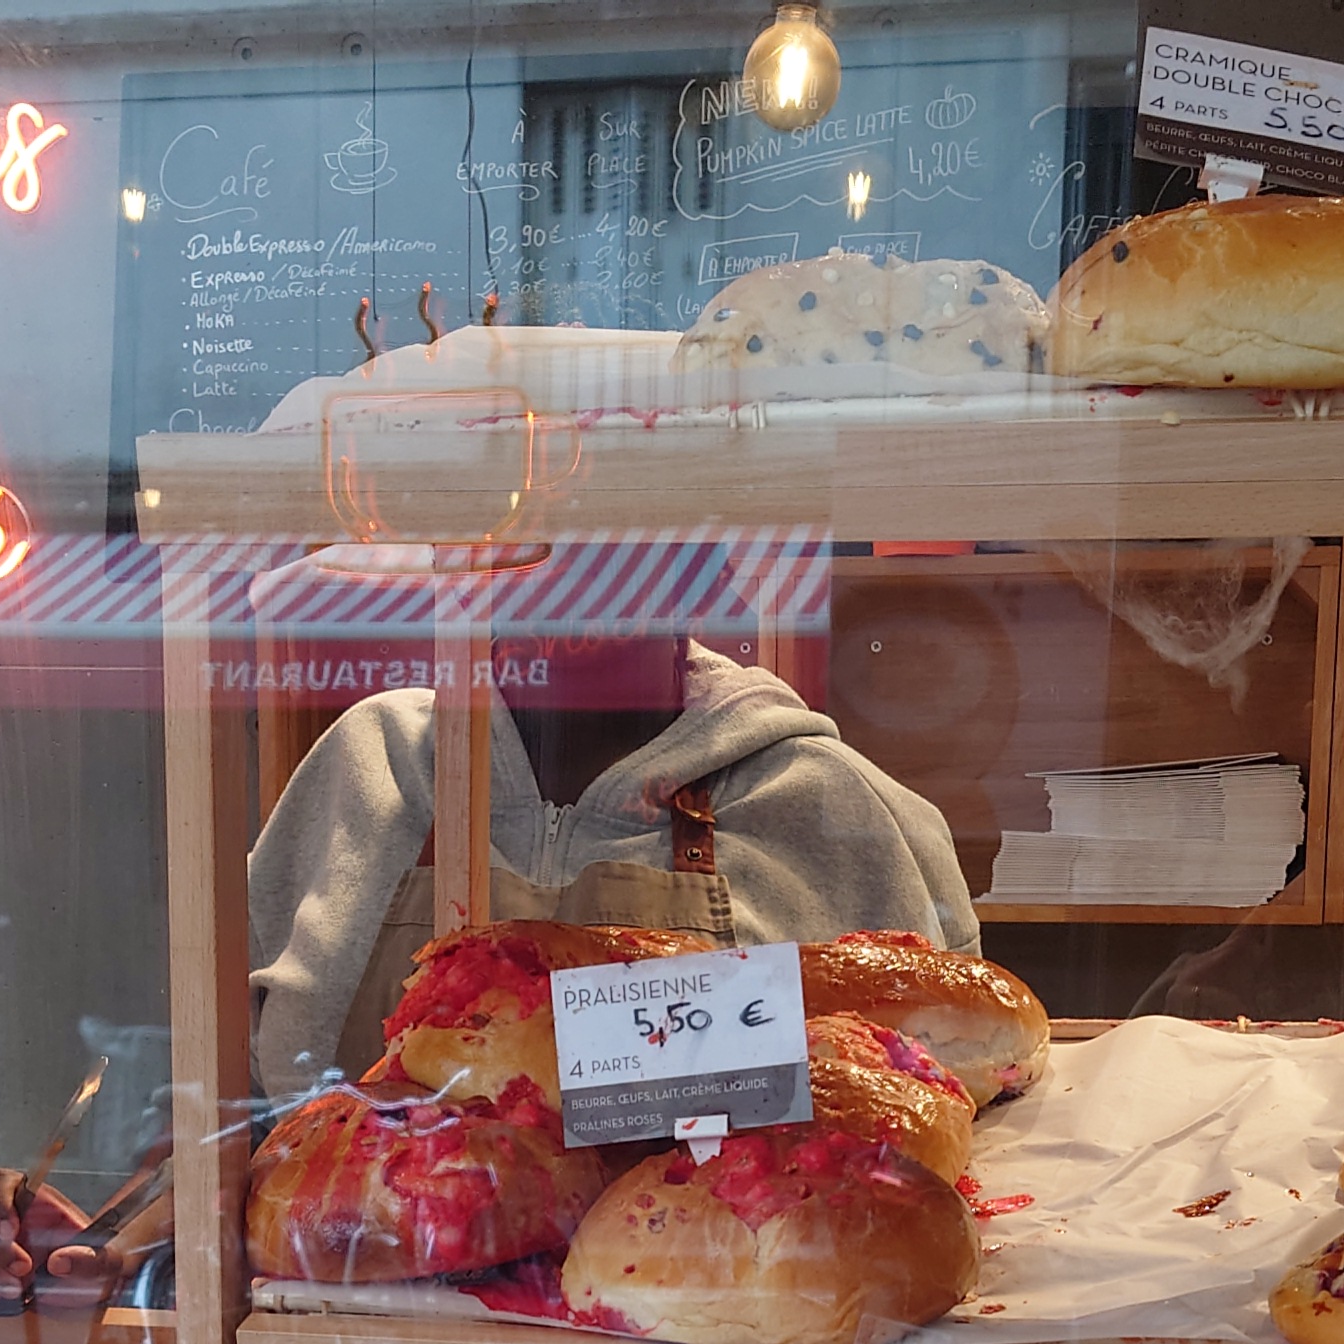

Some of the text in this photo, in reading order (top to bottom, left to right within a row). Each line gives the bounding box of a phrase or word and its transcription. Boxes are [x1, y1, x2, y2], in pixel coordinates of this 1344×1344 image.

[1155, 43, 1292, 81] CRAMIQUE
[1153, 66, 1256, 97] DOUBLE
[1150, 96, 1165, 111] 4
[1174, 100, 1229, 120] PARTS
[856, 105, 912, 137] LATTE
[588, 153, 647, 176] PLACE
[908, 137, 983, 185] 4,20€
[1268, 144, 1312, 163] CRÈME
[160, 125, 274, 210] Café
[456, 160, 559, 181] EMPORTER
[192, 337, 254, 356] Noisette
[193, 358, 269, 379] Capuccino
[563, 973, 713, 1010] PRALISIENNE
[569, 1055, 641, 1079] 4 PARTS
[573, 1113, 663, 1133] PRALINES ROSES
